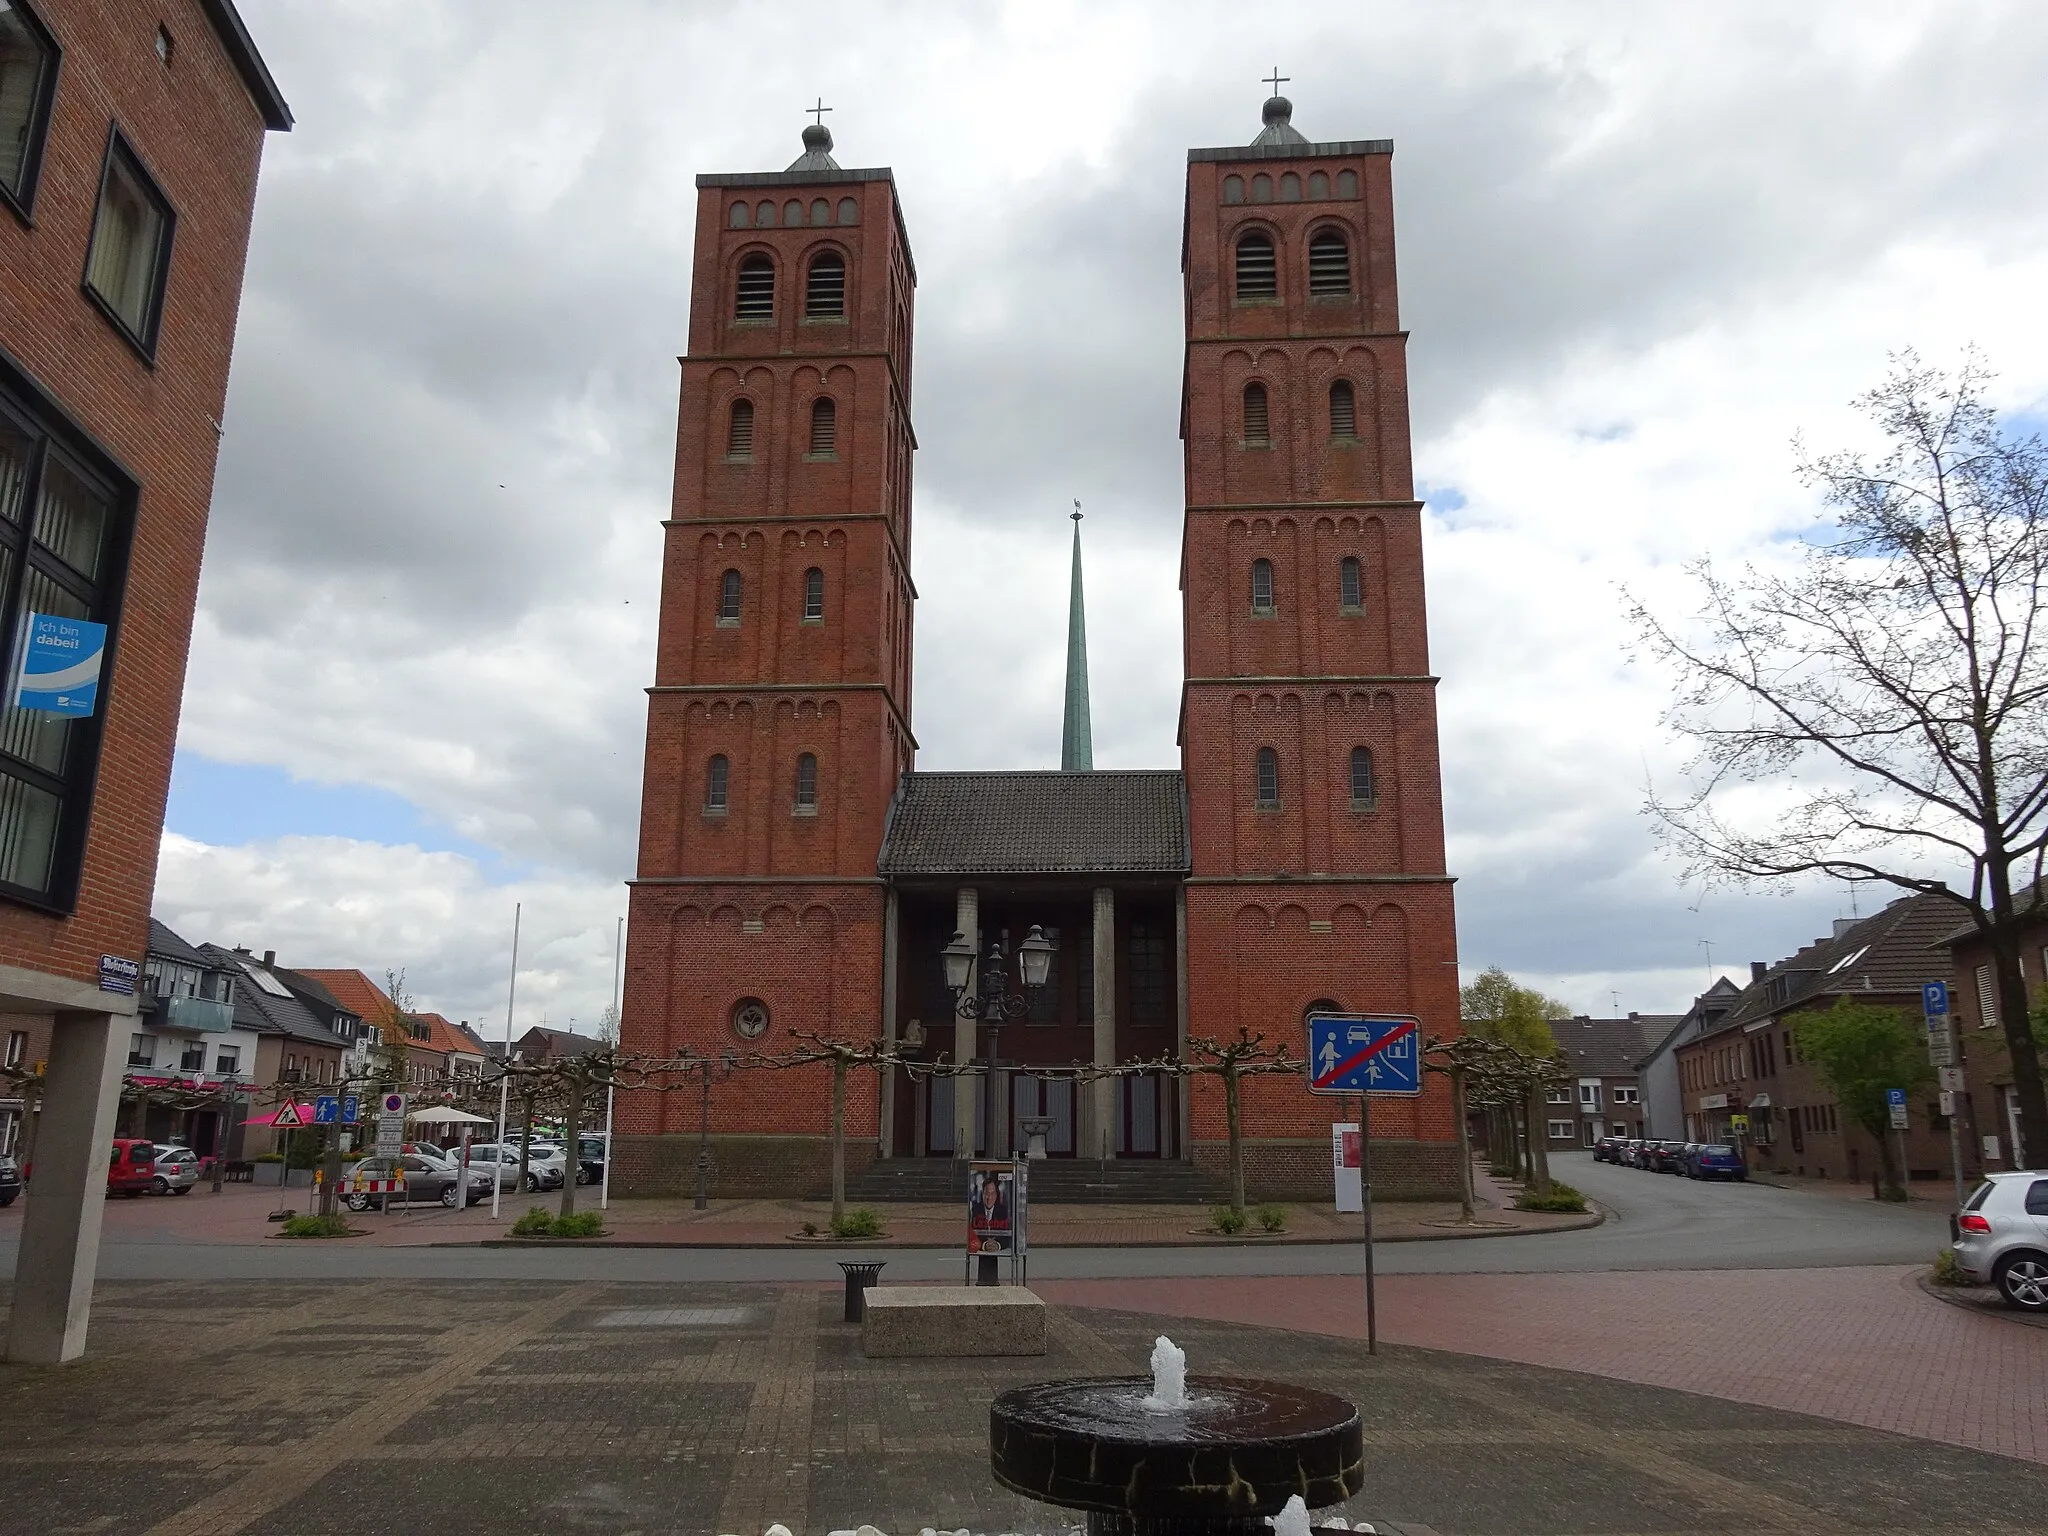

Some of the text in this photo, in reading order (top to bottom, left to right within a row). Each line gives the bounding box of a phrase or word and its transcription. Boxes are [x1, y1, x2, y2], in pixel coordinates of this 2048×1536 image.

[60, 624, 79, 637] bin
[36, 634, 79, 649] dabei!
[1928, 986, 1941, 1009] P
